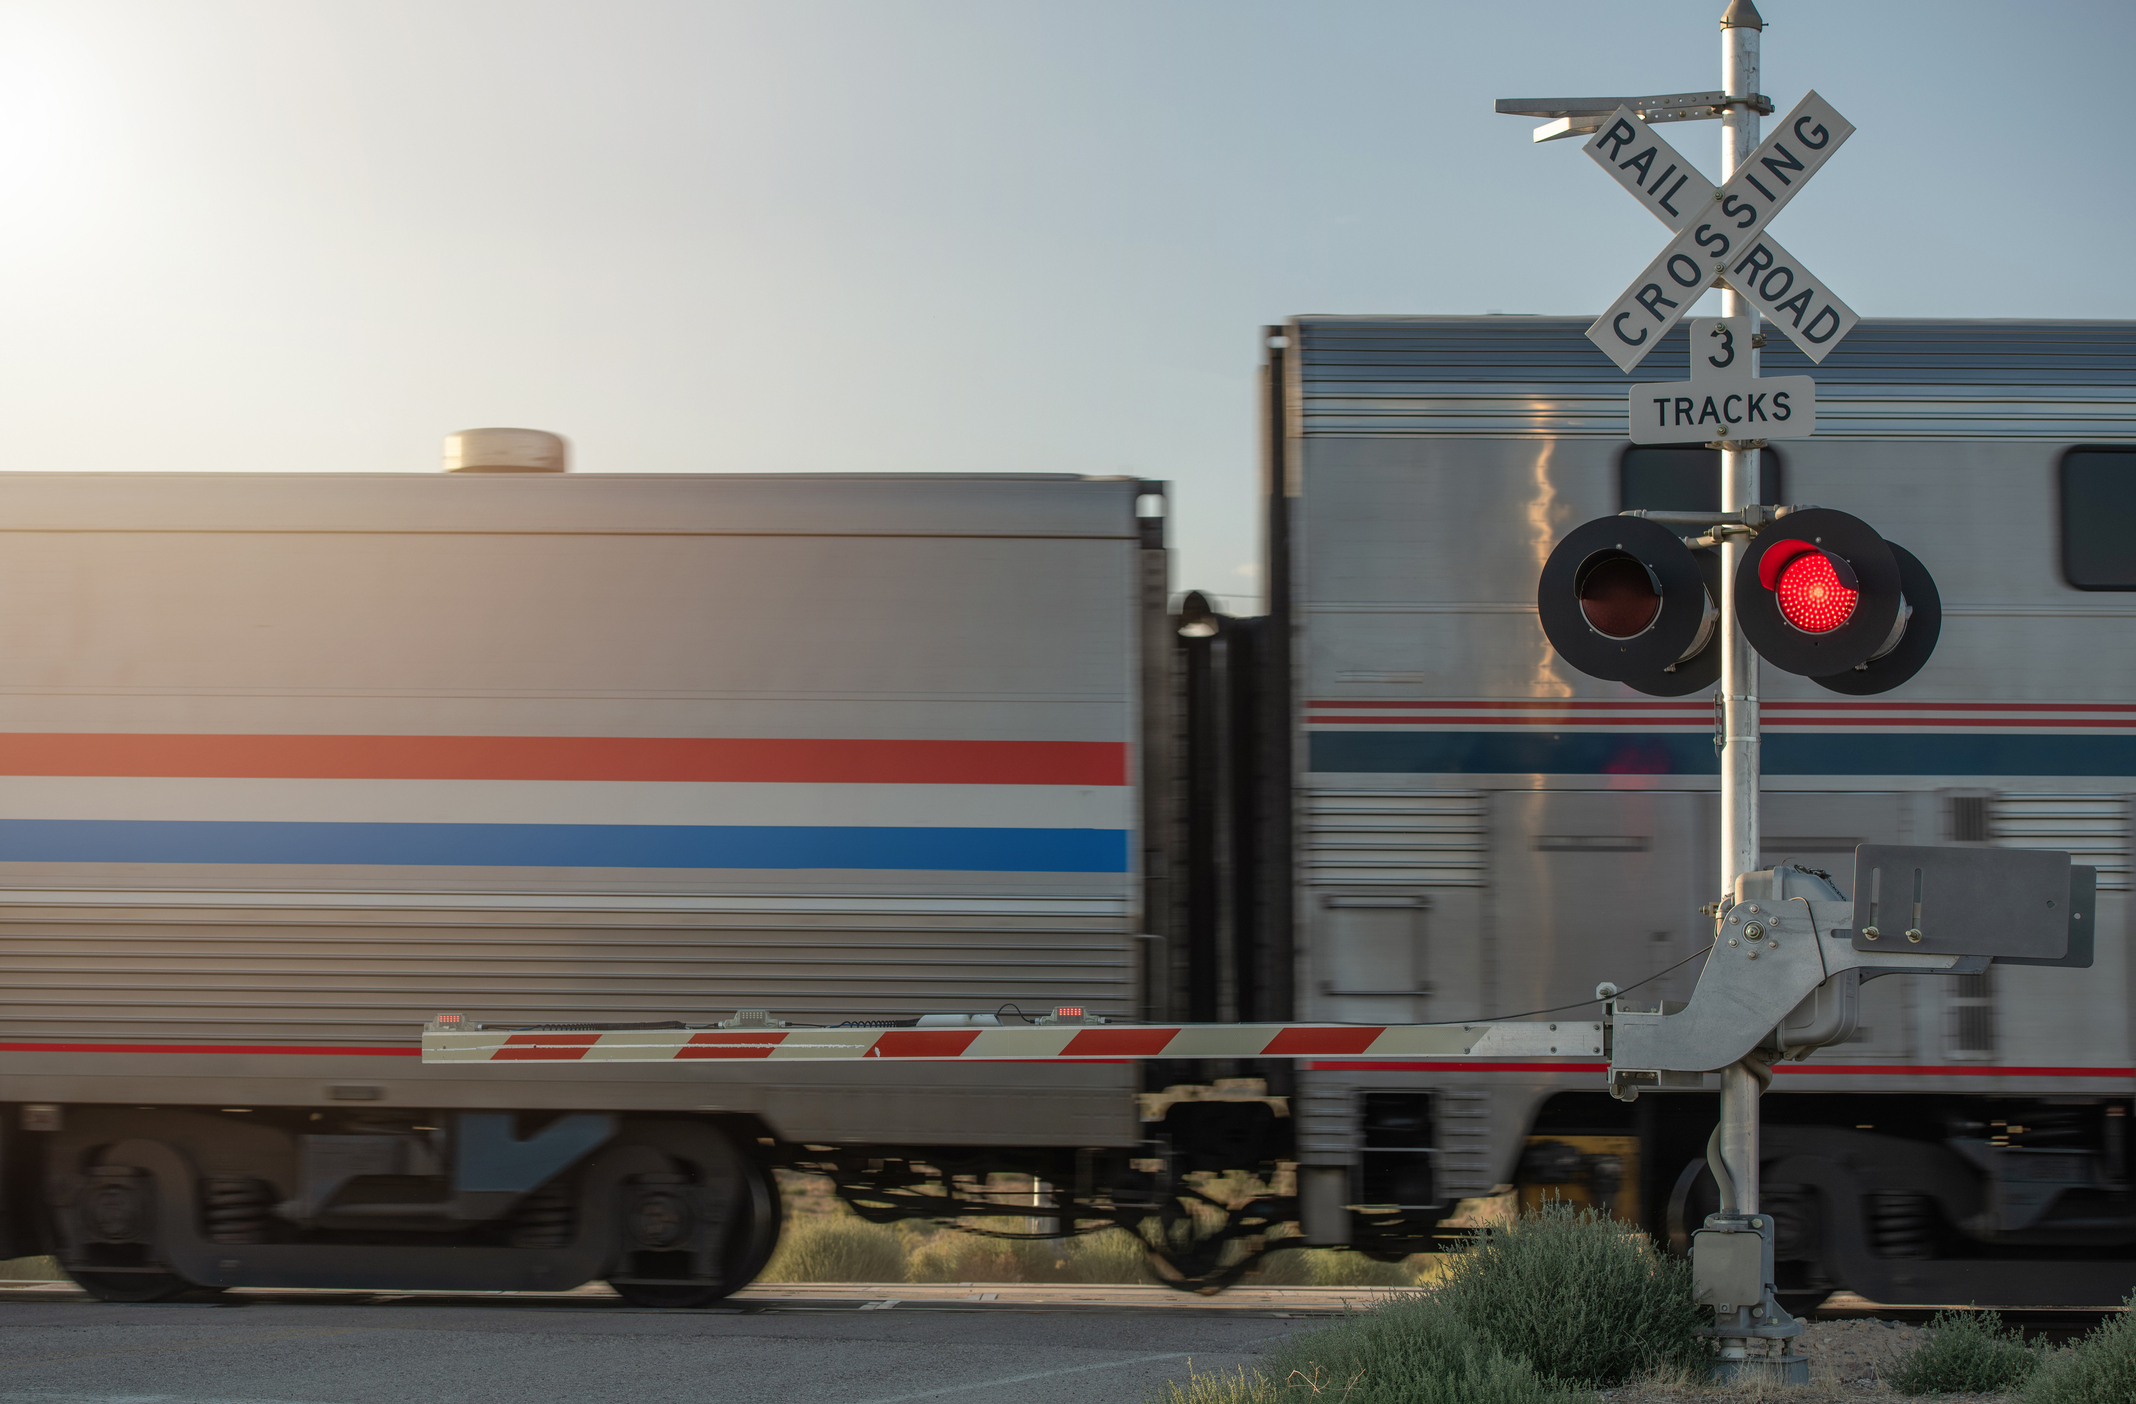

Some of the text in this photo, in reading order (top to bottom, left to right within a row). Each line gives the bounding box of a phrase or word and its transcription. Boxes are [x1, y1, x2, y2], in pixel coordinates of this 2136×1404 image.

[1596, 117, 1688, 218] RAIL
[1612, 115, 1830, 346] CROSSING
[1733, 242, 1841, 344] ROAD
[1708, 329, 1735, 368] 3
[1653, 391, 1791, 427] TRACKS
